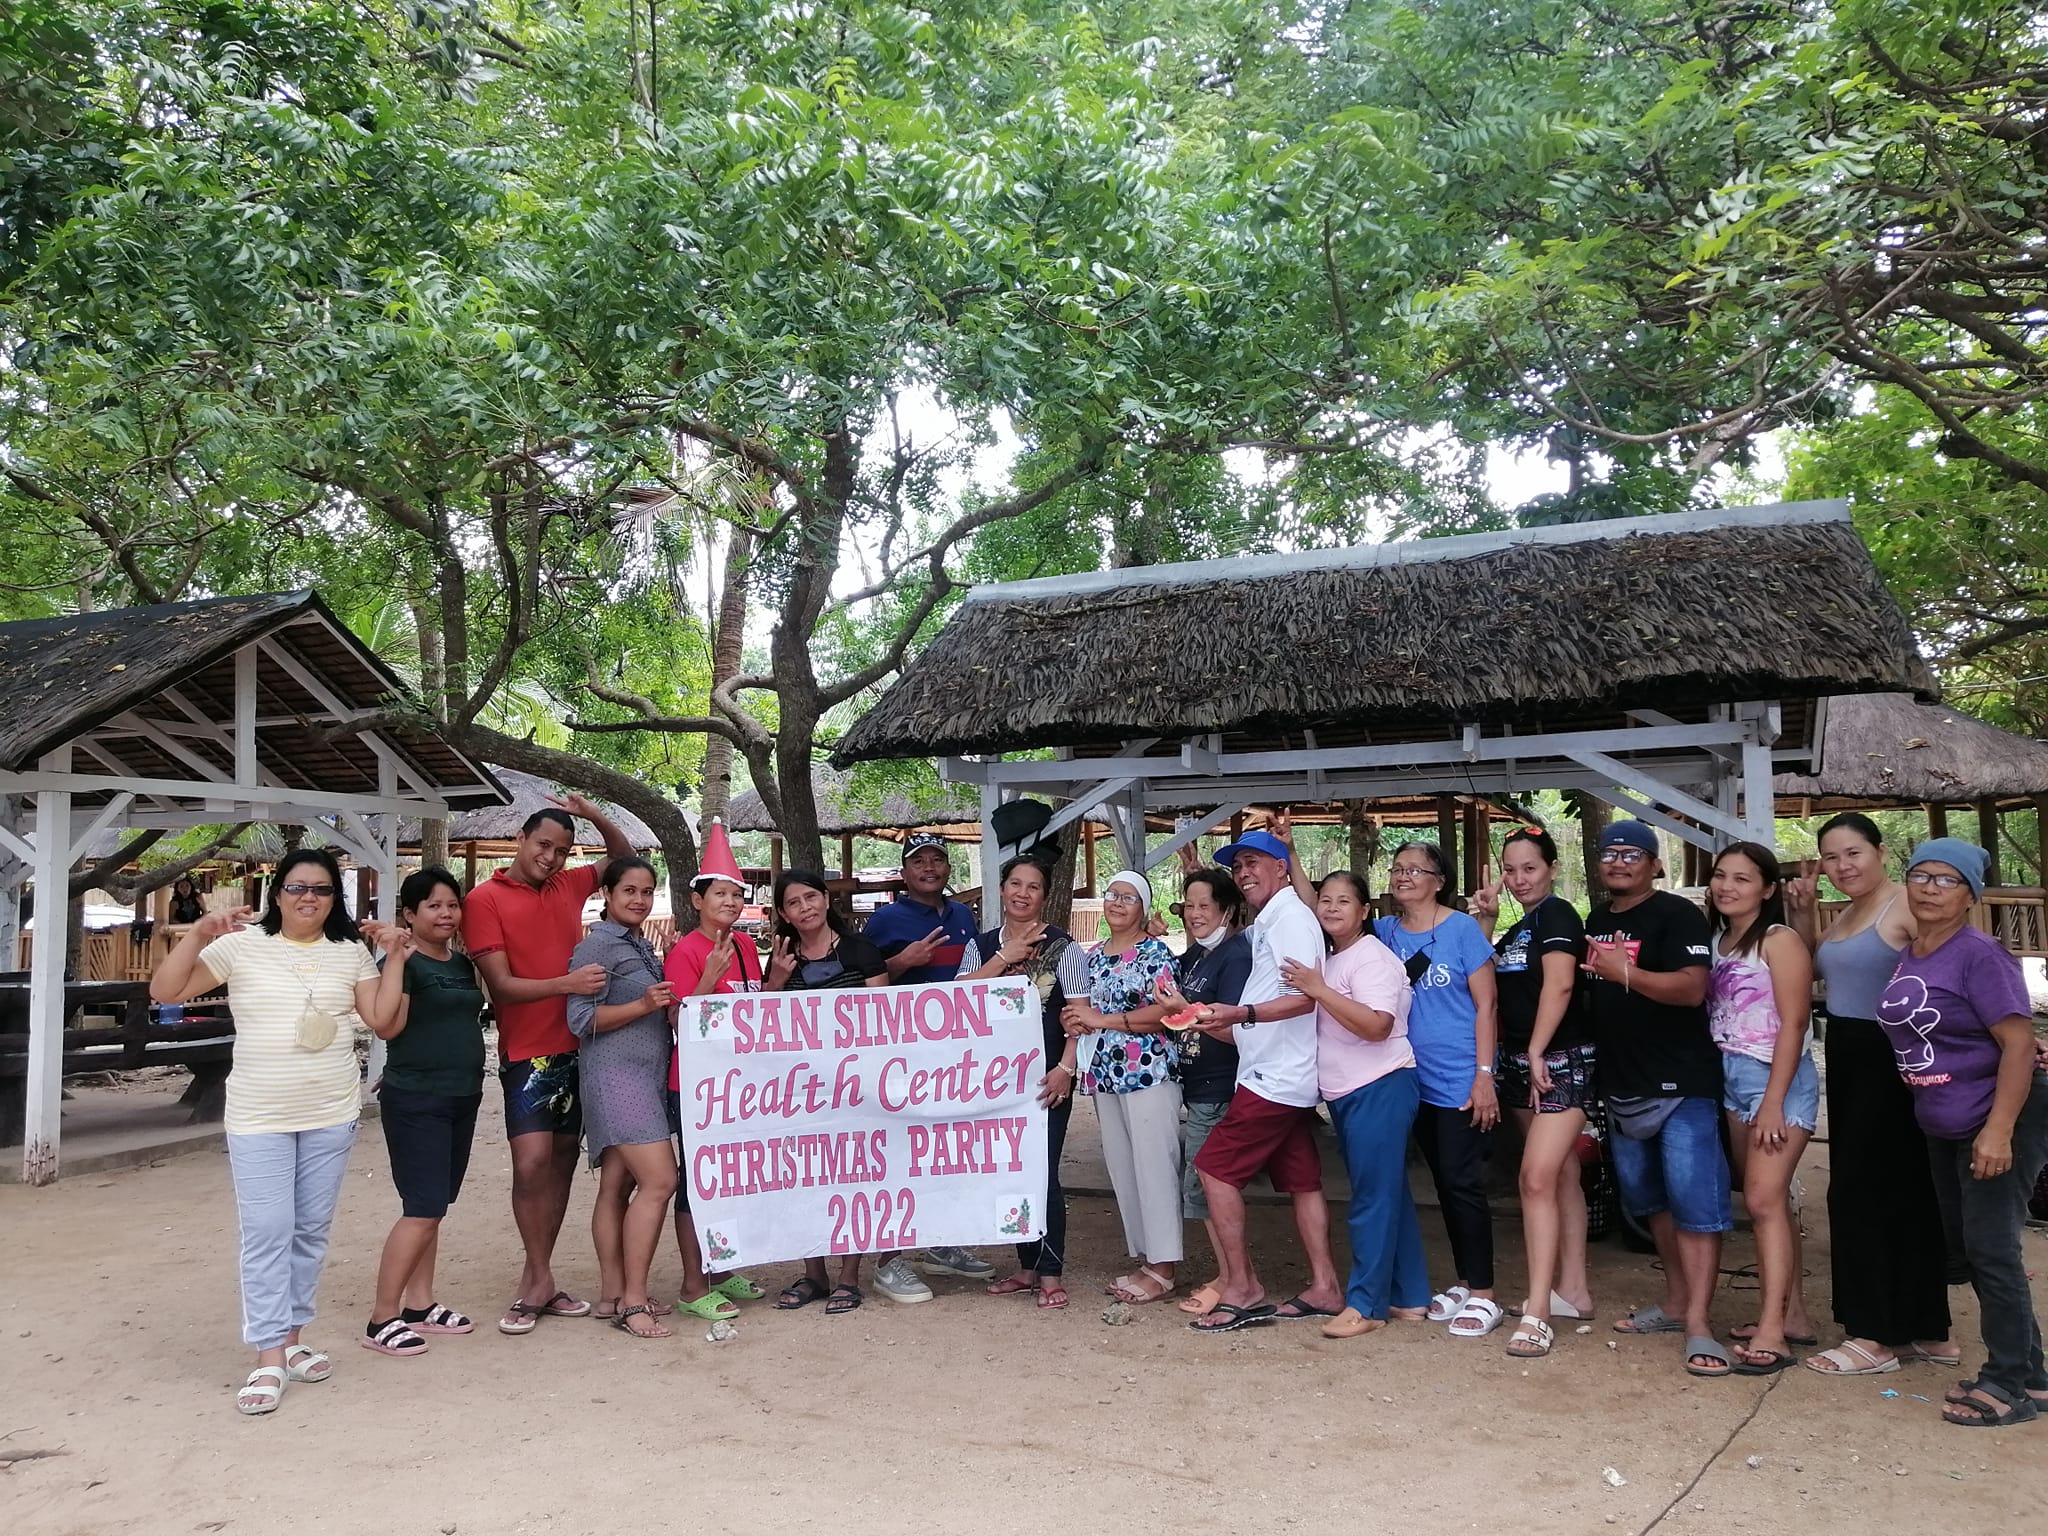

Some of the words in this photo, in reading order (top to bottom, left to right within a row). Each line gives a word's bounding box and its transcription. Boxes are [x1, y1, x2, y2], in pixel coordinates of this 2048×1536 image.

[732, 997, 823, 1054] SAN
[834, 984, 993, 1049] SIMON
[695, 1053, 865, 1131] Health
[878, 1047, 1041, 1113] Center
[693, 1129, 888, 1201] CHRISTMAS
[907, 1116, 1028, 1178] PARTY
[828, 1187, 917, 1255] 2022
